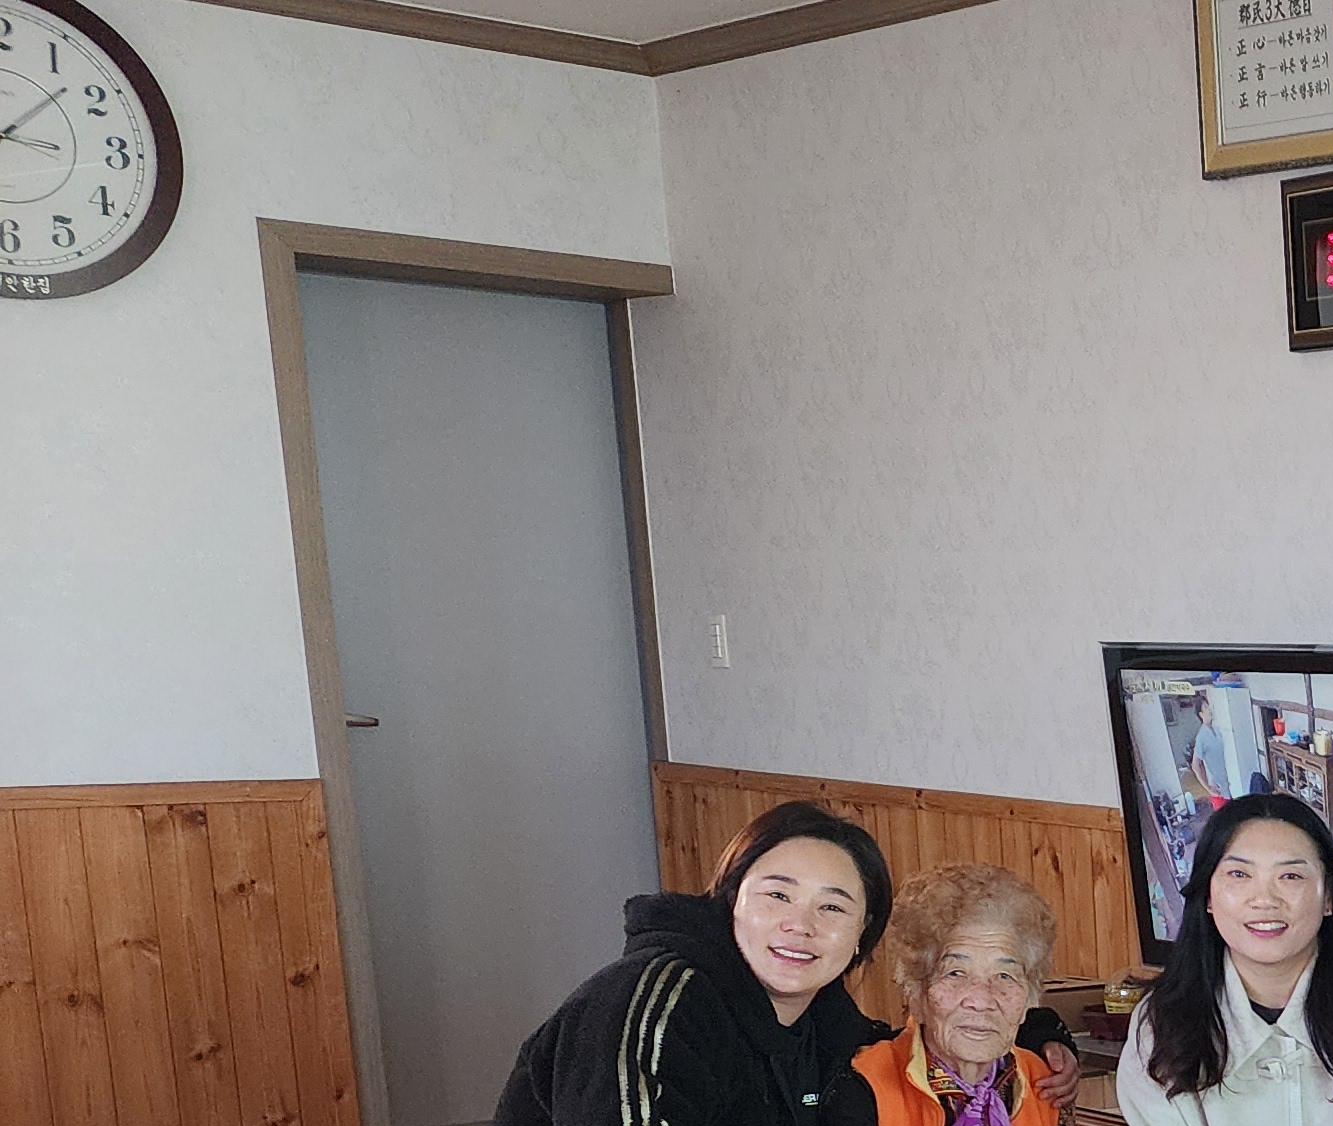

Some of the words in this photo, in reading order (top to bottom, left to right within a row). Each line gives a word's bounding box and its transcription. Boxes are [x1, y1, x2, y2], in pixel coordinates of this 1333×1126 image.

[48, 41, 60, 75] 1
[84, 84, 108, 117] 2
[105, 136, 130, 170] 3
[88, 185, 116, 217] 4
[0, 219, 21, 253] 6
[52, 215, 76, 248] 5
